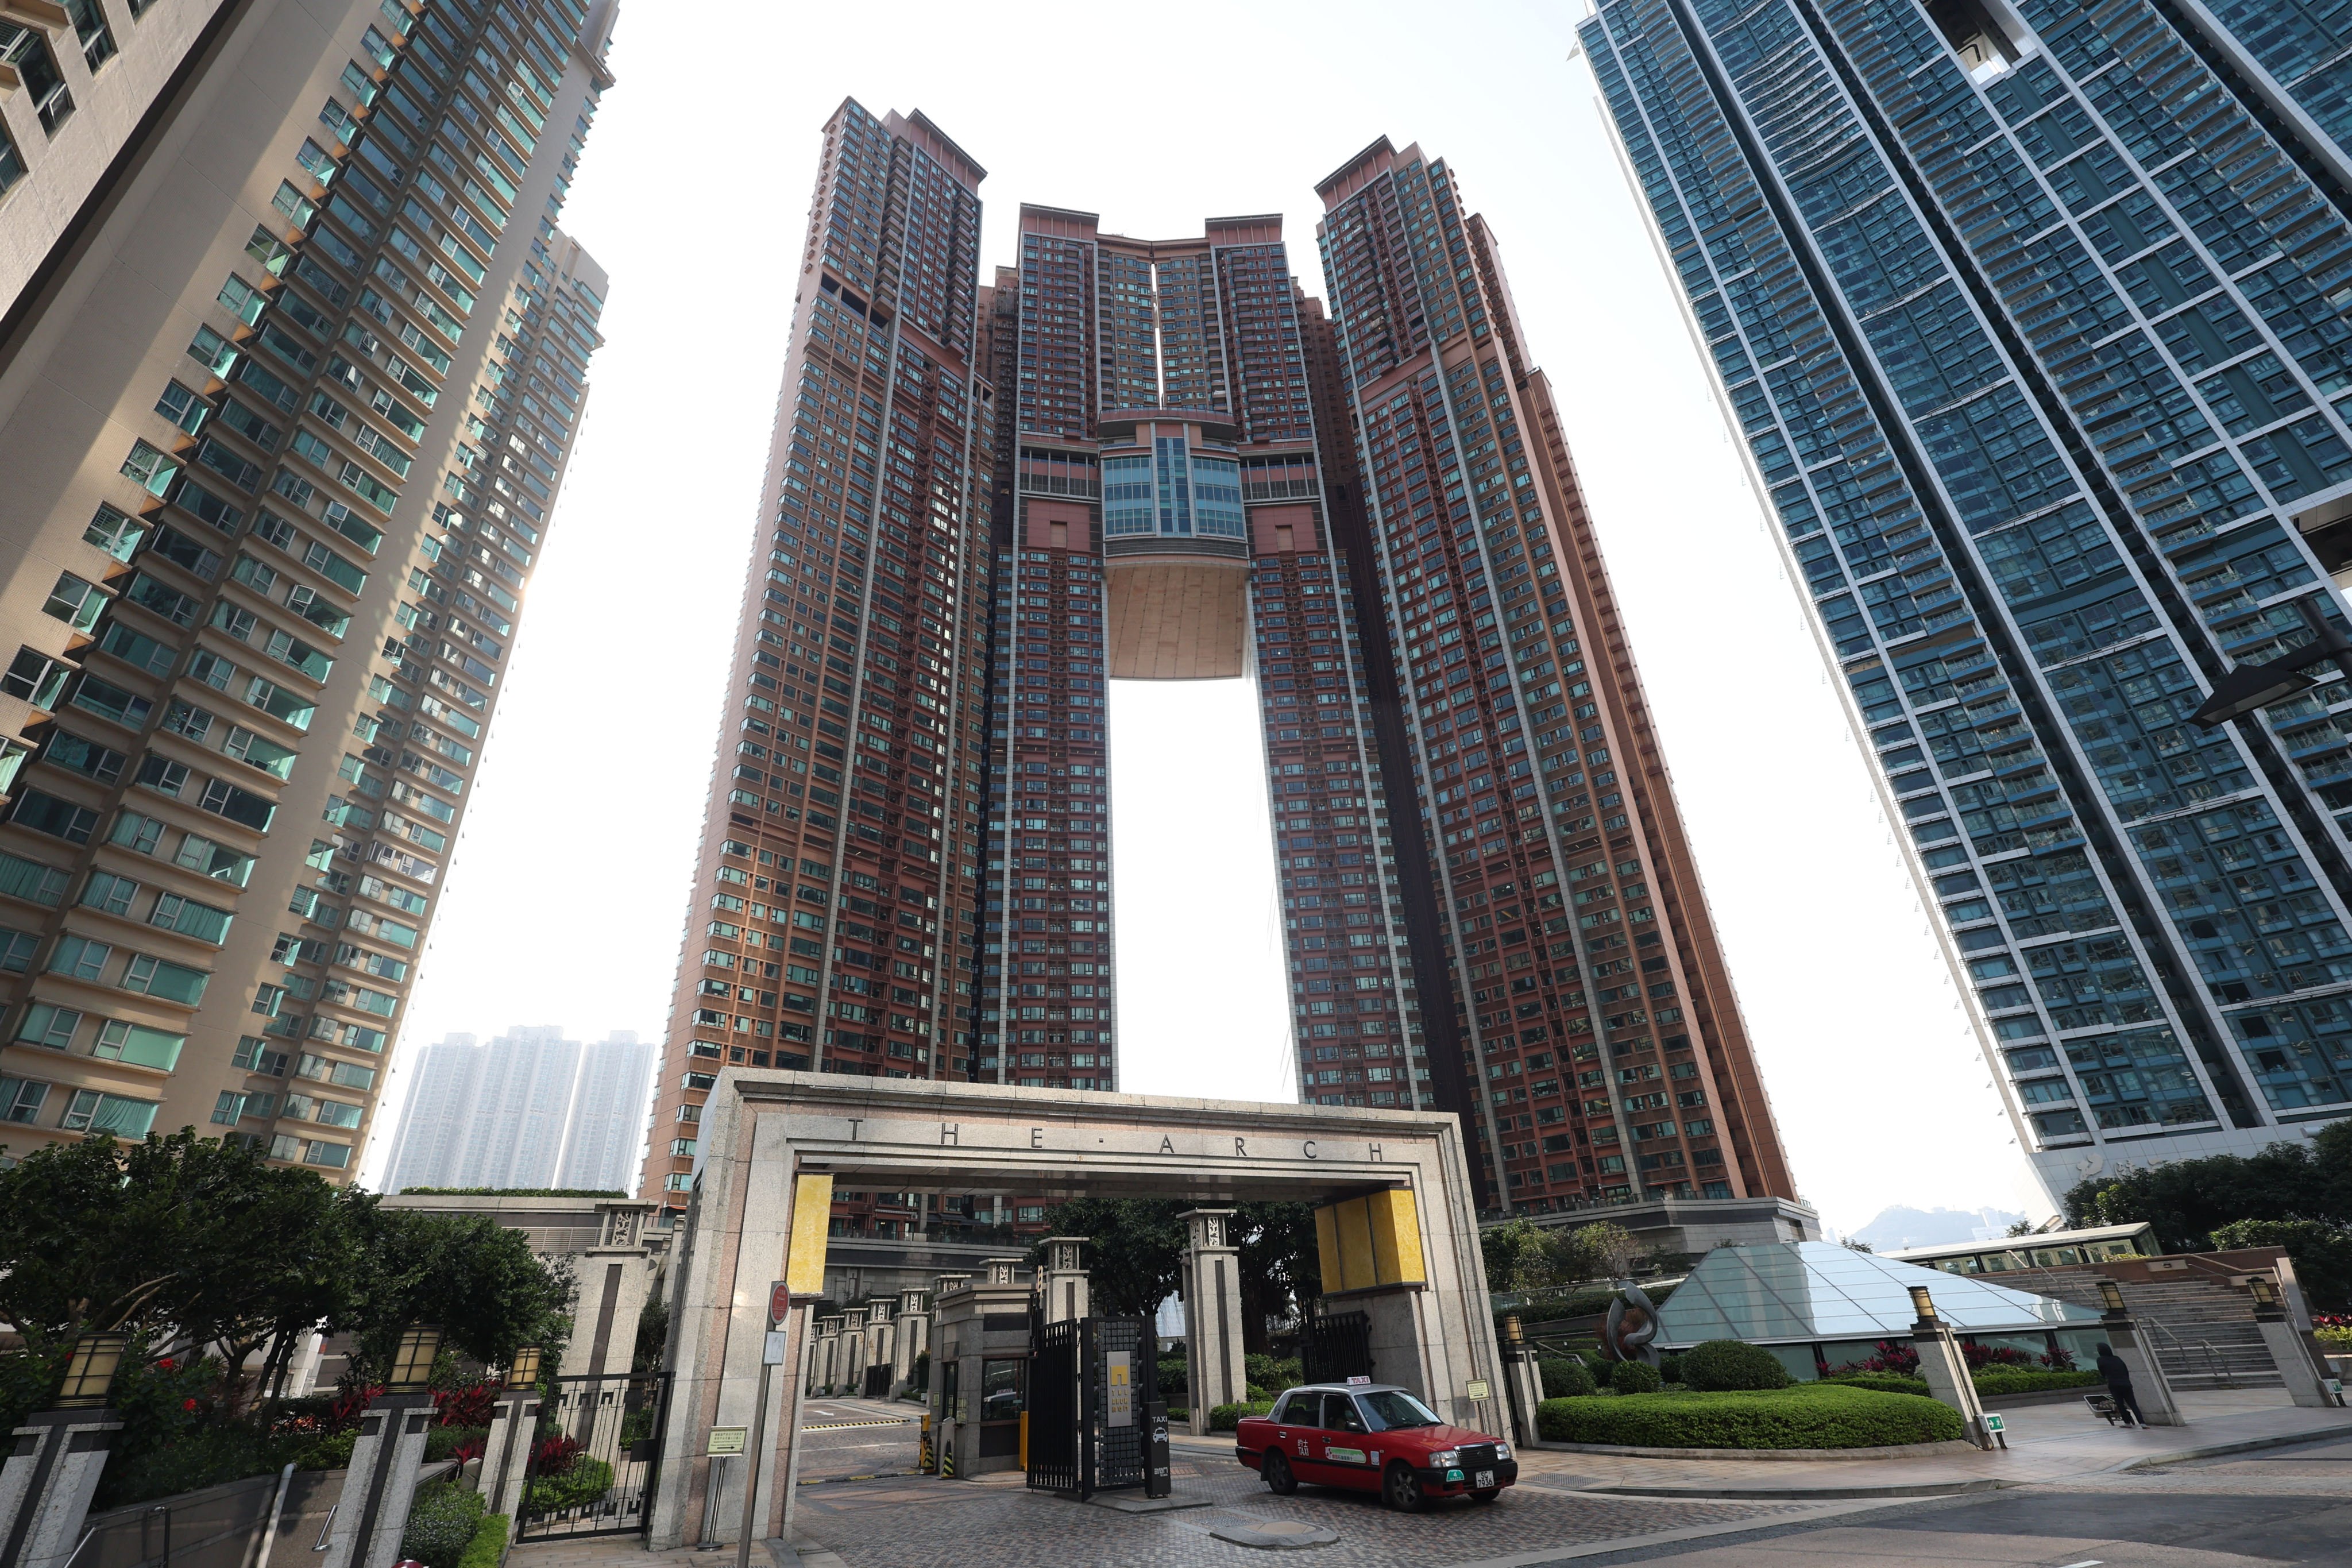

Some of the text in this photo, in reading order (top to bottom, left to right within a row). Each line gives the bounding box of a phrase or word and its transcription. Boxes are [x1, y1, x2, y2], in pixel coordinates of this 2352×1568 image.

[848, 1118, 1042, 1148] THE
[1160, 1134, 1382, 1161] ARCH
[1297, 1438, 1308, 1447] 的士
[1297, 1447, 1309, 1456] TAXI
[1478, 1478, 1493, 1488] 7936
